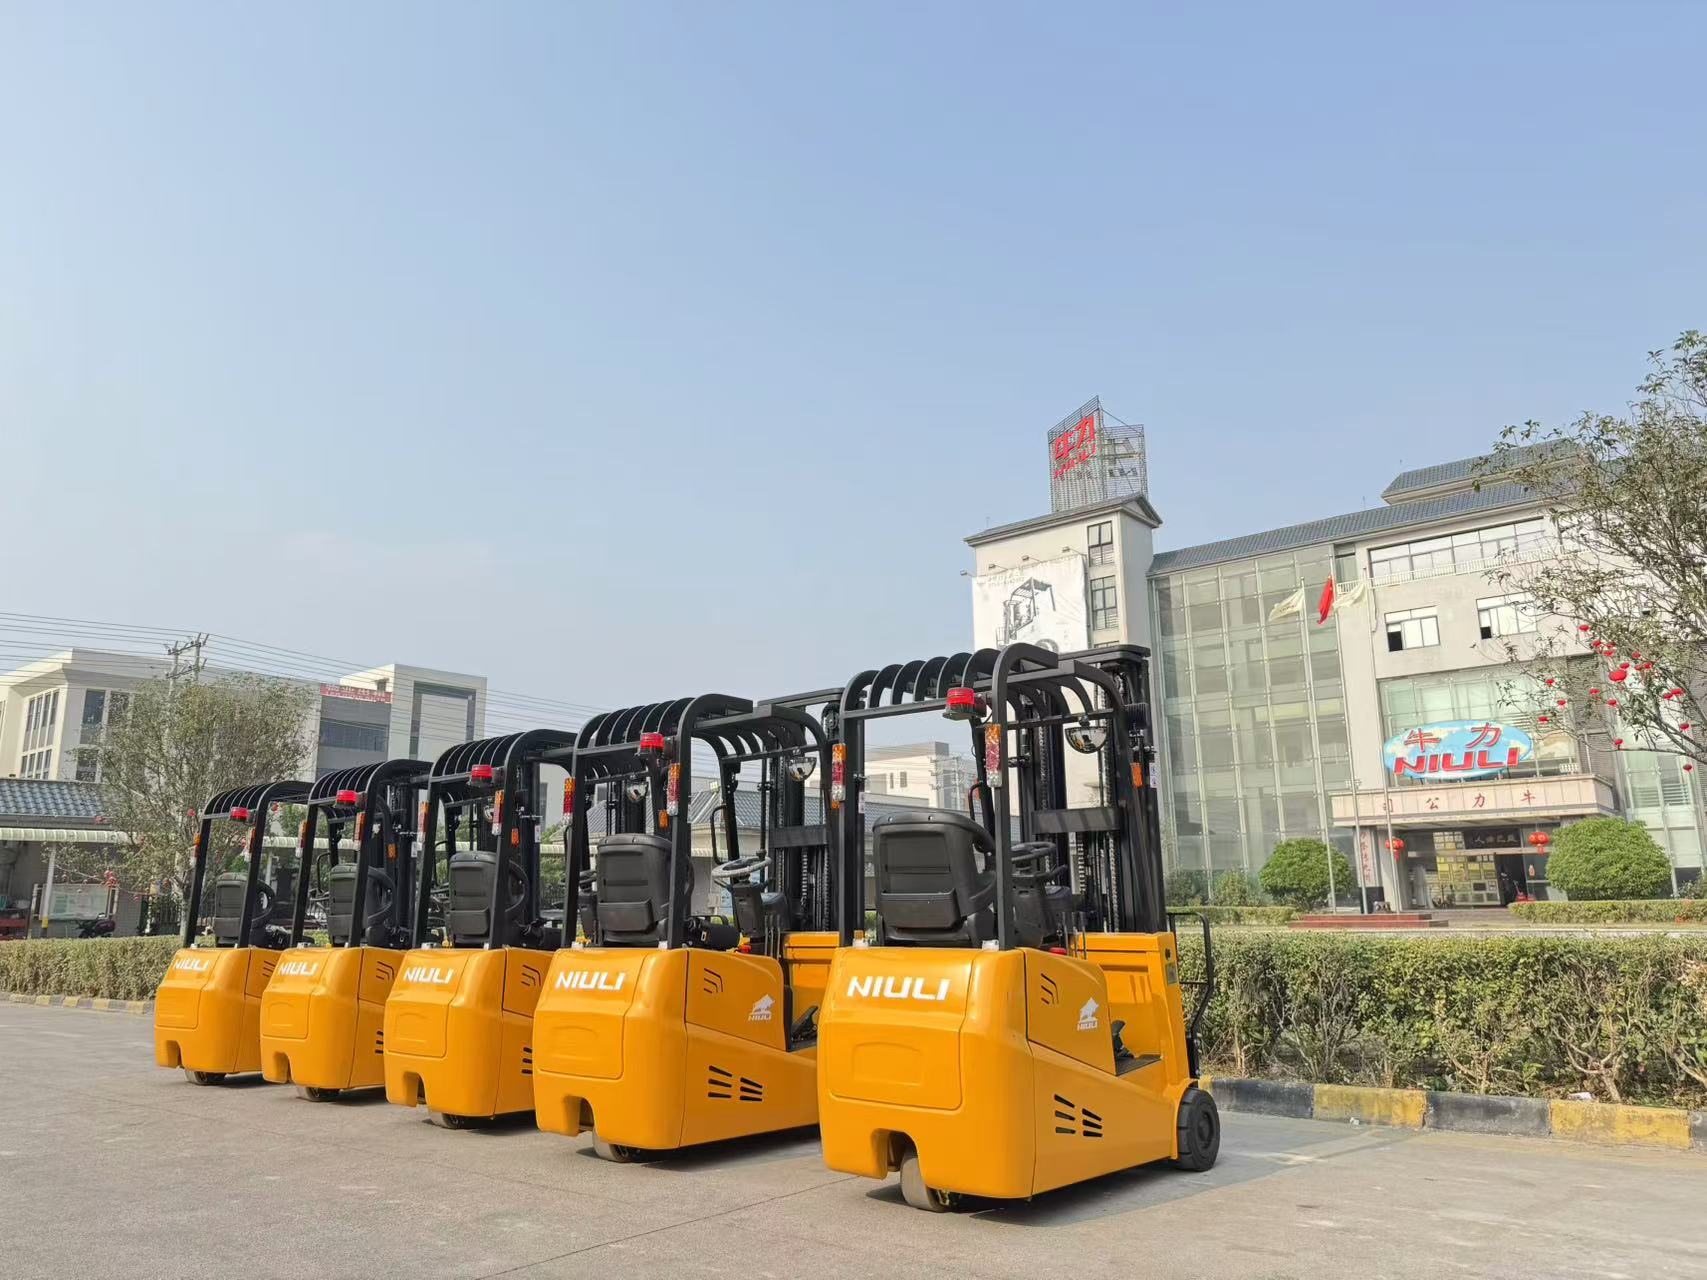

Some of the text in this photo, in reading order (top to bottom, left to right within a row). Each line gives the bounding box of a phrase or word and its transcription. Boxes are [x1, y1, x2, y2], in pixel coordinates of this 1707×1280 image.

[1404, 722, 1502, 752] 牛力
[1394, 747, 1520, 775] NIULI
[173, 959, 210, 971] NIULI
[279, 962, 319, 976] NIULI
[403, 967, 454, 984] NIULI
[555, 971, 626, 991] NIULI
[847, 976, 951, 1001] NIULI
